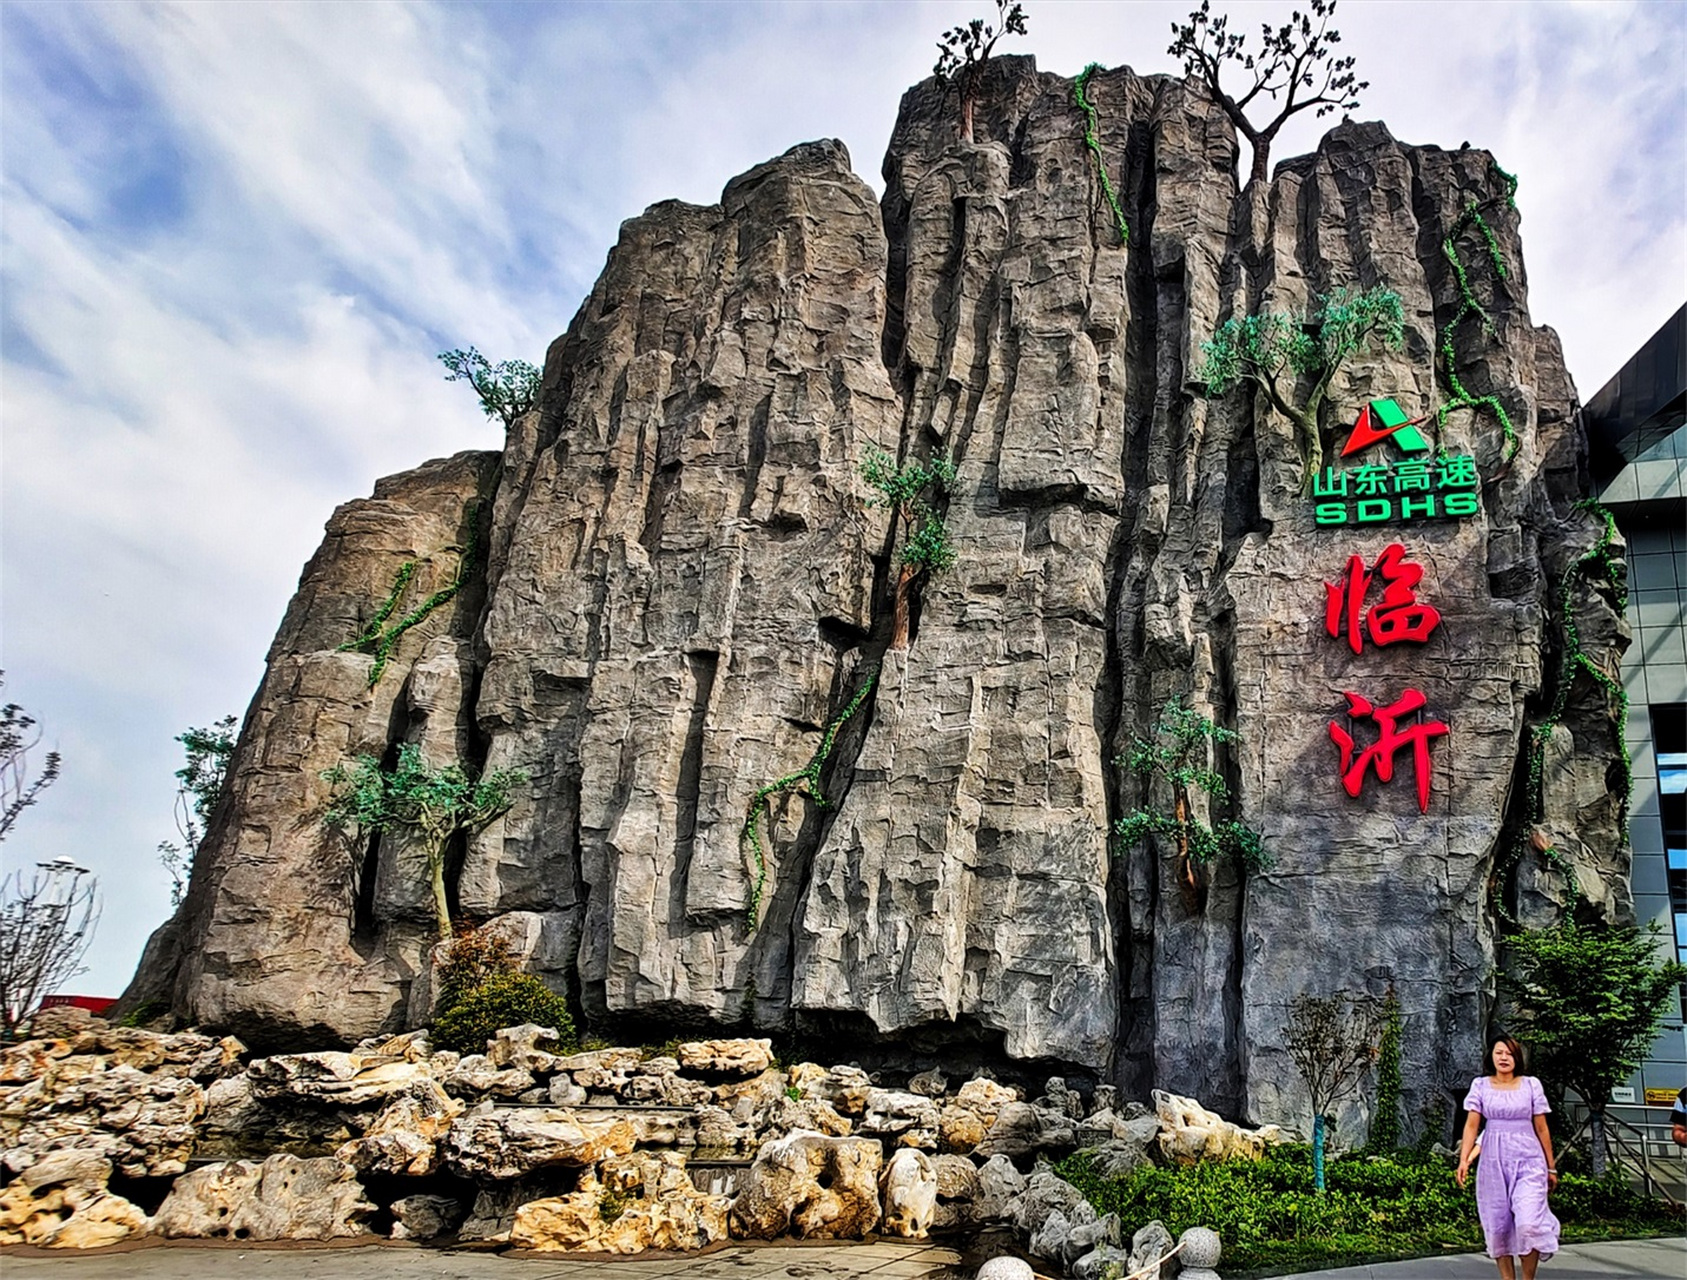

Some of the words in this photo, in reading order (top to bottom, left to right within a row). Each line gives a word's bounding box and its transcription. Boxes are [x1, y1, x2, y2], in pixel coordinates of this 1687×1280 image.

[1313, 454, 1477, 497] 山东高速
[1315, 492, 1479, 525] SDHS
[1324, 543, 1450, 814] 临沂
